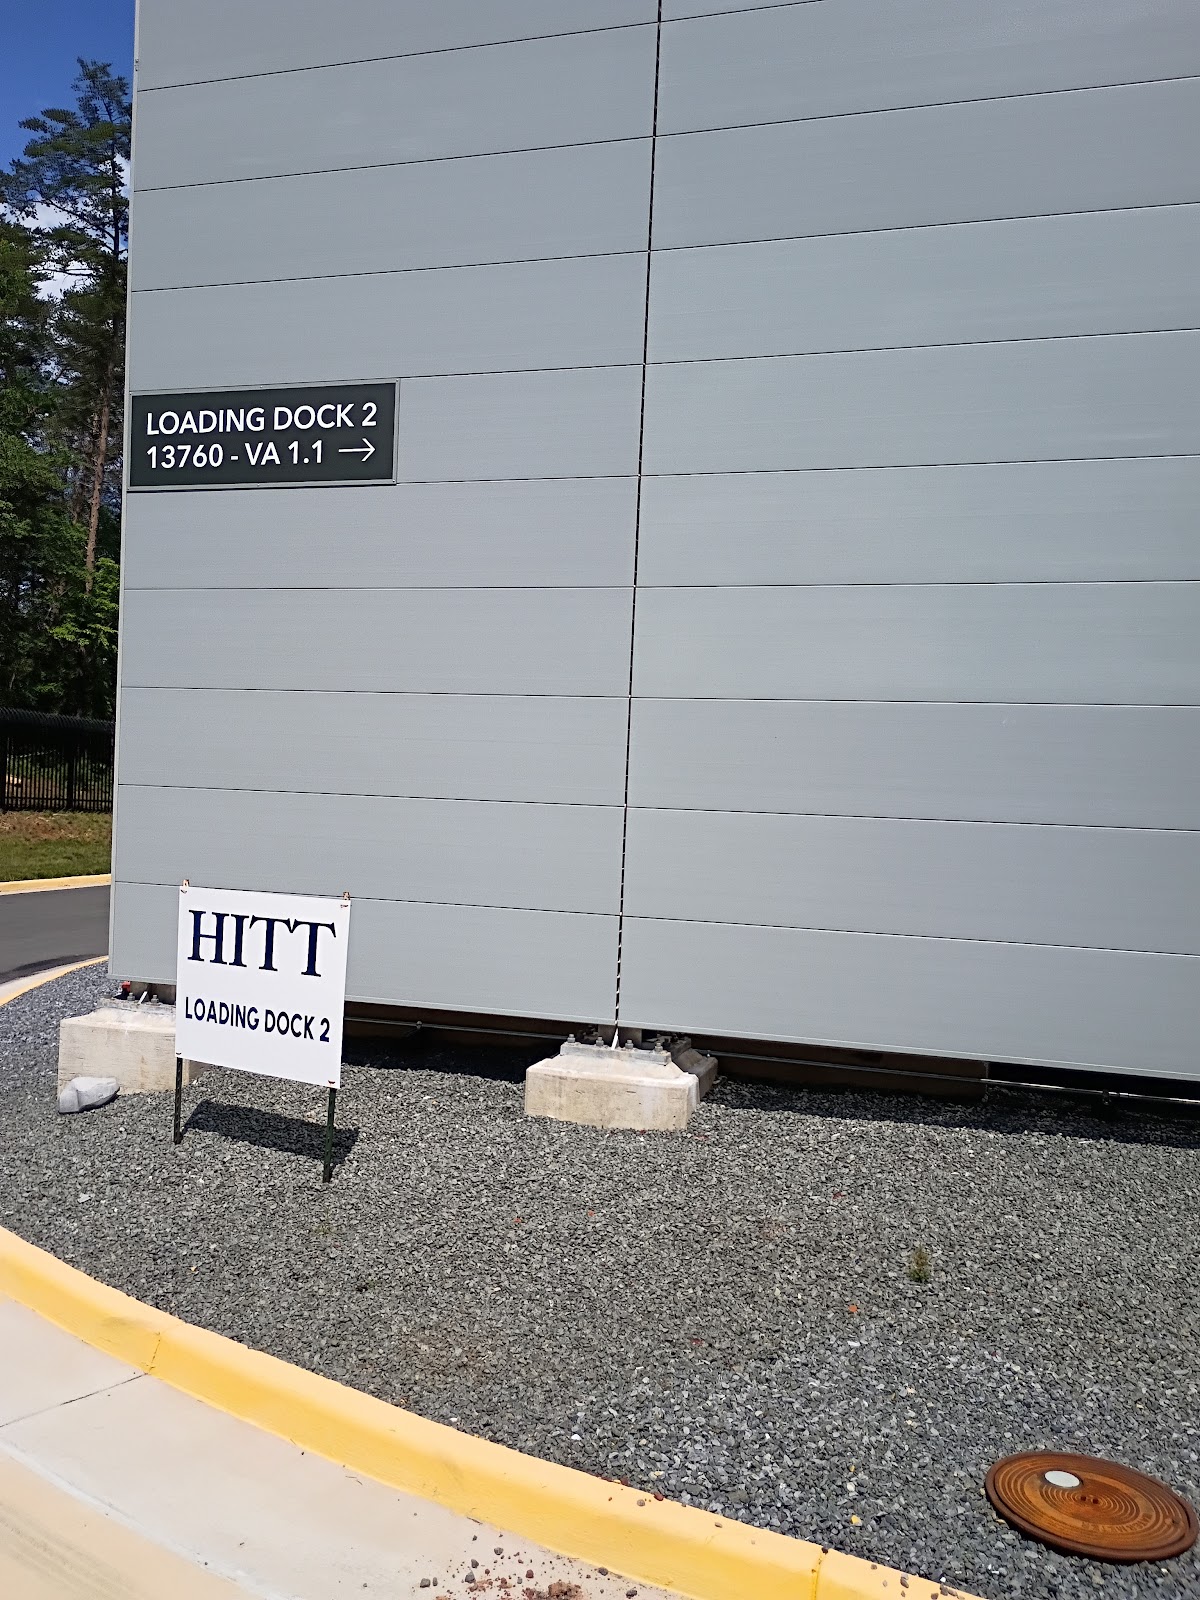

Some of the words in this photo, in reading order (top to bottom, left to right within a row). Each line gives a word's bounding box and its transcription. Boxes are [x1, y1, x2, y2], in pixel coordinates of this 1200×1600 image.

[146, 408, 265, 435] LOADING
[273, 404, 354, 430] DOCK
[361, 402, 377, 426] 2
[146, 443, 224, 469] 13760
[244, 442, 281, 466] VA
[288, 440, 322, 464] 1.1
[187, 909, 337, 977] HITT
[185, 996, 260, 1031] LOADING
[264, 1009, 315, 1040] DOCK
[319, 1017, 331, 1042] 2
